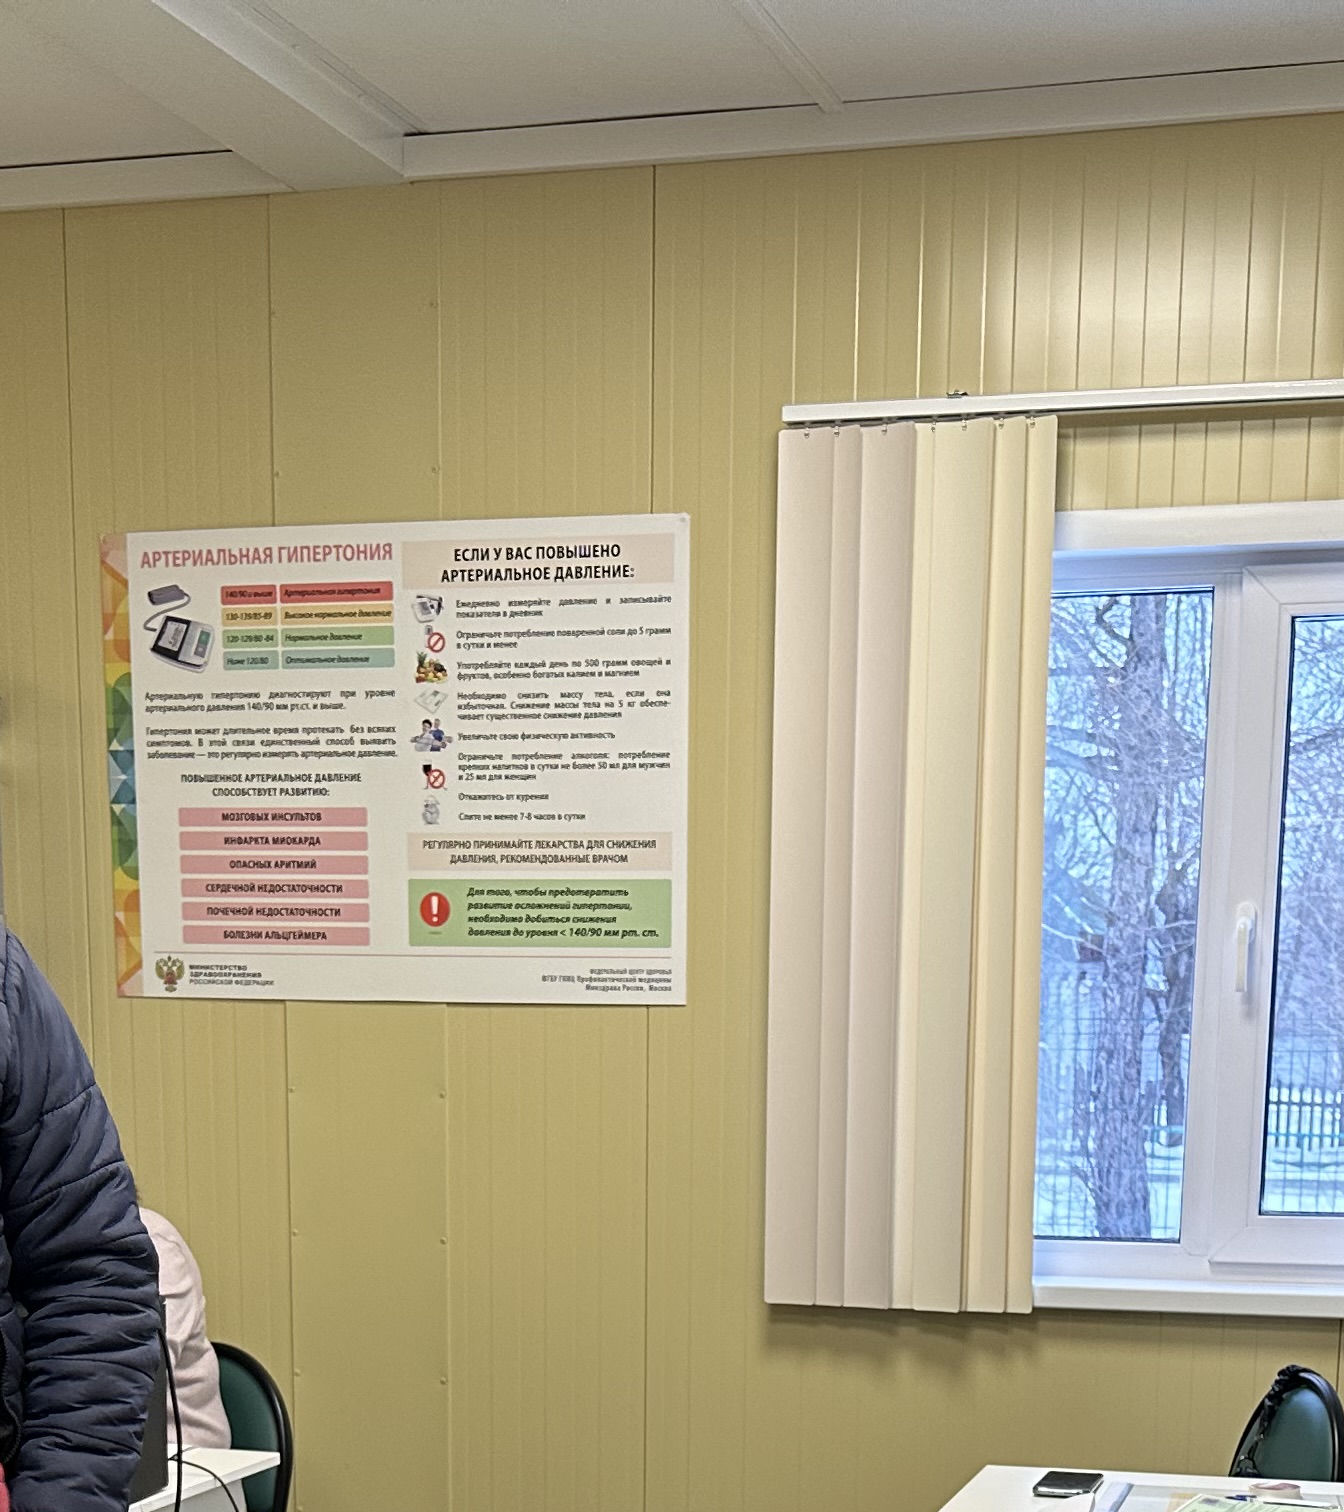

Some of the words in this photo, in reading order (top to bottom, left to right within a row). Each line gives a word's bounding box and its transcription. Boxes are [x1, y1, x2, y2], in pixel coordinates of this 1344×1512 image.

[140, 547, 273, 569] АРТЕРИАЛЬНАЯ
[278, 543, 393, 564] ГИПЕРТОНИЯ
[454, 549, 490, 562] ЕСЛИ
[506, 547, 532, 561] ВАС
[536, 544, 620, 559] ПОВЫШЕНО
[441, 567, 551, 583] АРТЕРИАЛЬНОЕ
[553, 564, 635, 582] ДАВЛЕНИЕ:
[247, 702, 274, 711] 140/90
[350, 724, 364, 733] без
[181, 774, 243, 783] ПОВЫШЕННОЕ
[245, 774, 313, 783] АРТЕРИАЛЬНОЕ
[315, 773, 362, 783] ДАВЛЕНИЕ
[212, 788, 277, 797] СПОСОБСТВУЕТ
[279, 788, 330, 796] РАЗВИТИЮ:
[222, 813, 269, 821] МОЗГОВЫХ
[271, 813, 322, 821] ИНСУЛЬТОВ
[224, 837, 270, 846] ИНФАРКТА
[272, 837, 321, 846] МИОКАРДА
[423, 840, 471, 849] РЕГУЛЯРНО
[473, 838, 533, 849] ПРИНИМАЙТЕ
[534, 840, 584, 849] ЛЕКАРСТВА
[586, 840, 604, 850] ДЛЯ
[607, 840, 656, 848] СНИЖЕНИЯ
[229, 860, 271, 869] ОПАСНЫХ
[274, 858, 316, 869] АРИТМИЙ
[450, 854, 498, 864] ДАВЛЕНИЯ,
[500, 854, 590, 864] РЕКОМЕНДОВАННЫЕ
[592, 854, 628, 863] ВРАЧОМ
[205, 882, 256, 893] СЕРДЕЧНОЙ
[257, 884, 343, 893] НЕДОСТАТОЧНОСТИ
[467, 888, 484, 897] Для
[514, 888, 547, 897] чтобы
[548, 888, 629, 897] предотвратить
[207, 906, 253, 916] ПОЧЕЧНОЙ
[256, 908, 341, 917] НЕДОСТАТОЧНОСТИ
[468, 914, 523, 923] необходимо
[525, 914, 570, 923] добиться
[224, 930, 263, 940] БОЛЕЗНИ
[264, 930, 327, 942] АЛЬЦГЕЙМЕРА
[569, 928, 602, 937] 140/90
[604, 929, 619, 937] мм
